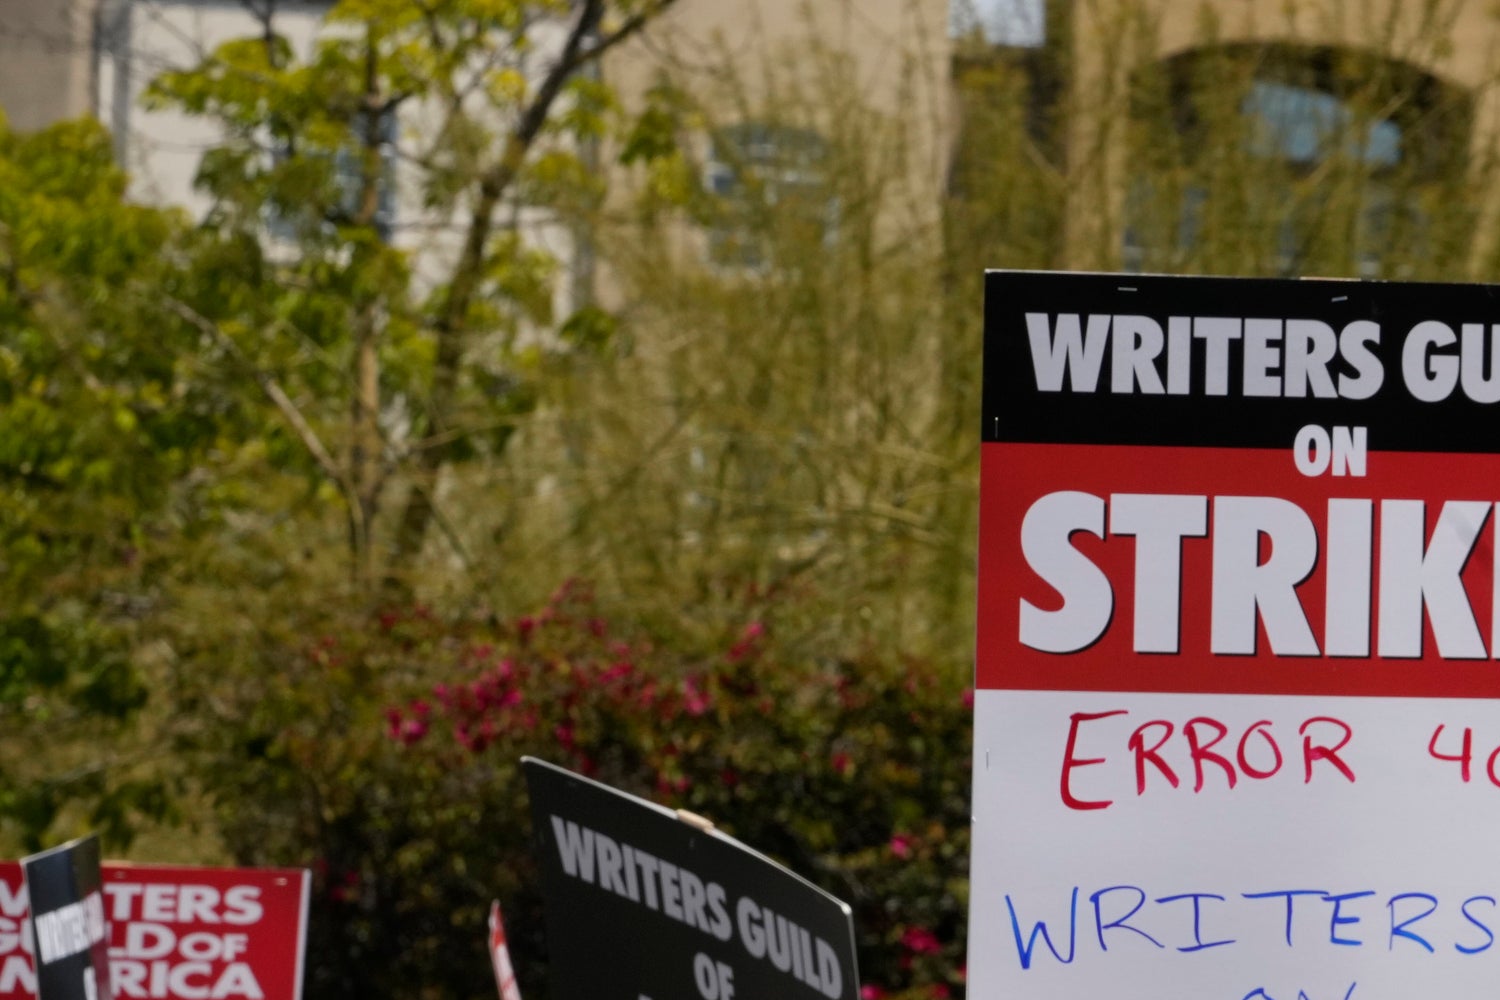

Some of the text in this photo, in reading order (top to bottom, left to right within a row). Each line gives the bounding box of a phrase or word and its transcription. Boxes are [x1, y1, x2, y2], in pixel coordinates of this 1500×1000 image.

[1024, 311, 1385, 399] WRITERS
[1293, 424, 1368, 478] ON
[1060, 709, 1356, 811] ERROR
[551, 814, 843, 1000] WRITERS GUILD
[1005, 886, 1497, 970] WRITERS
